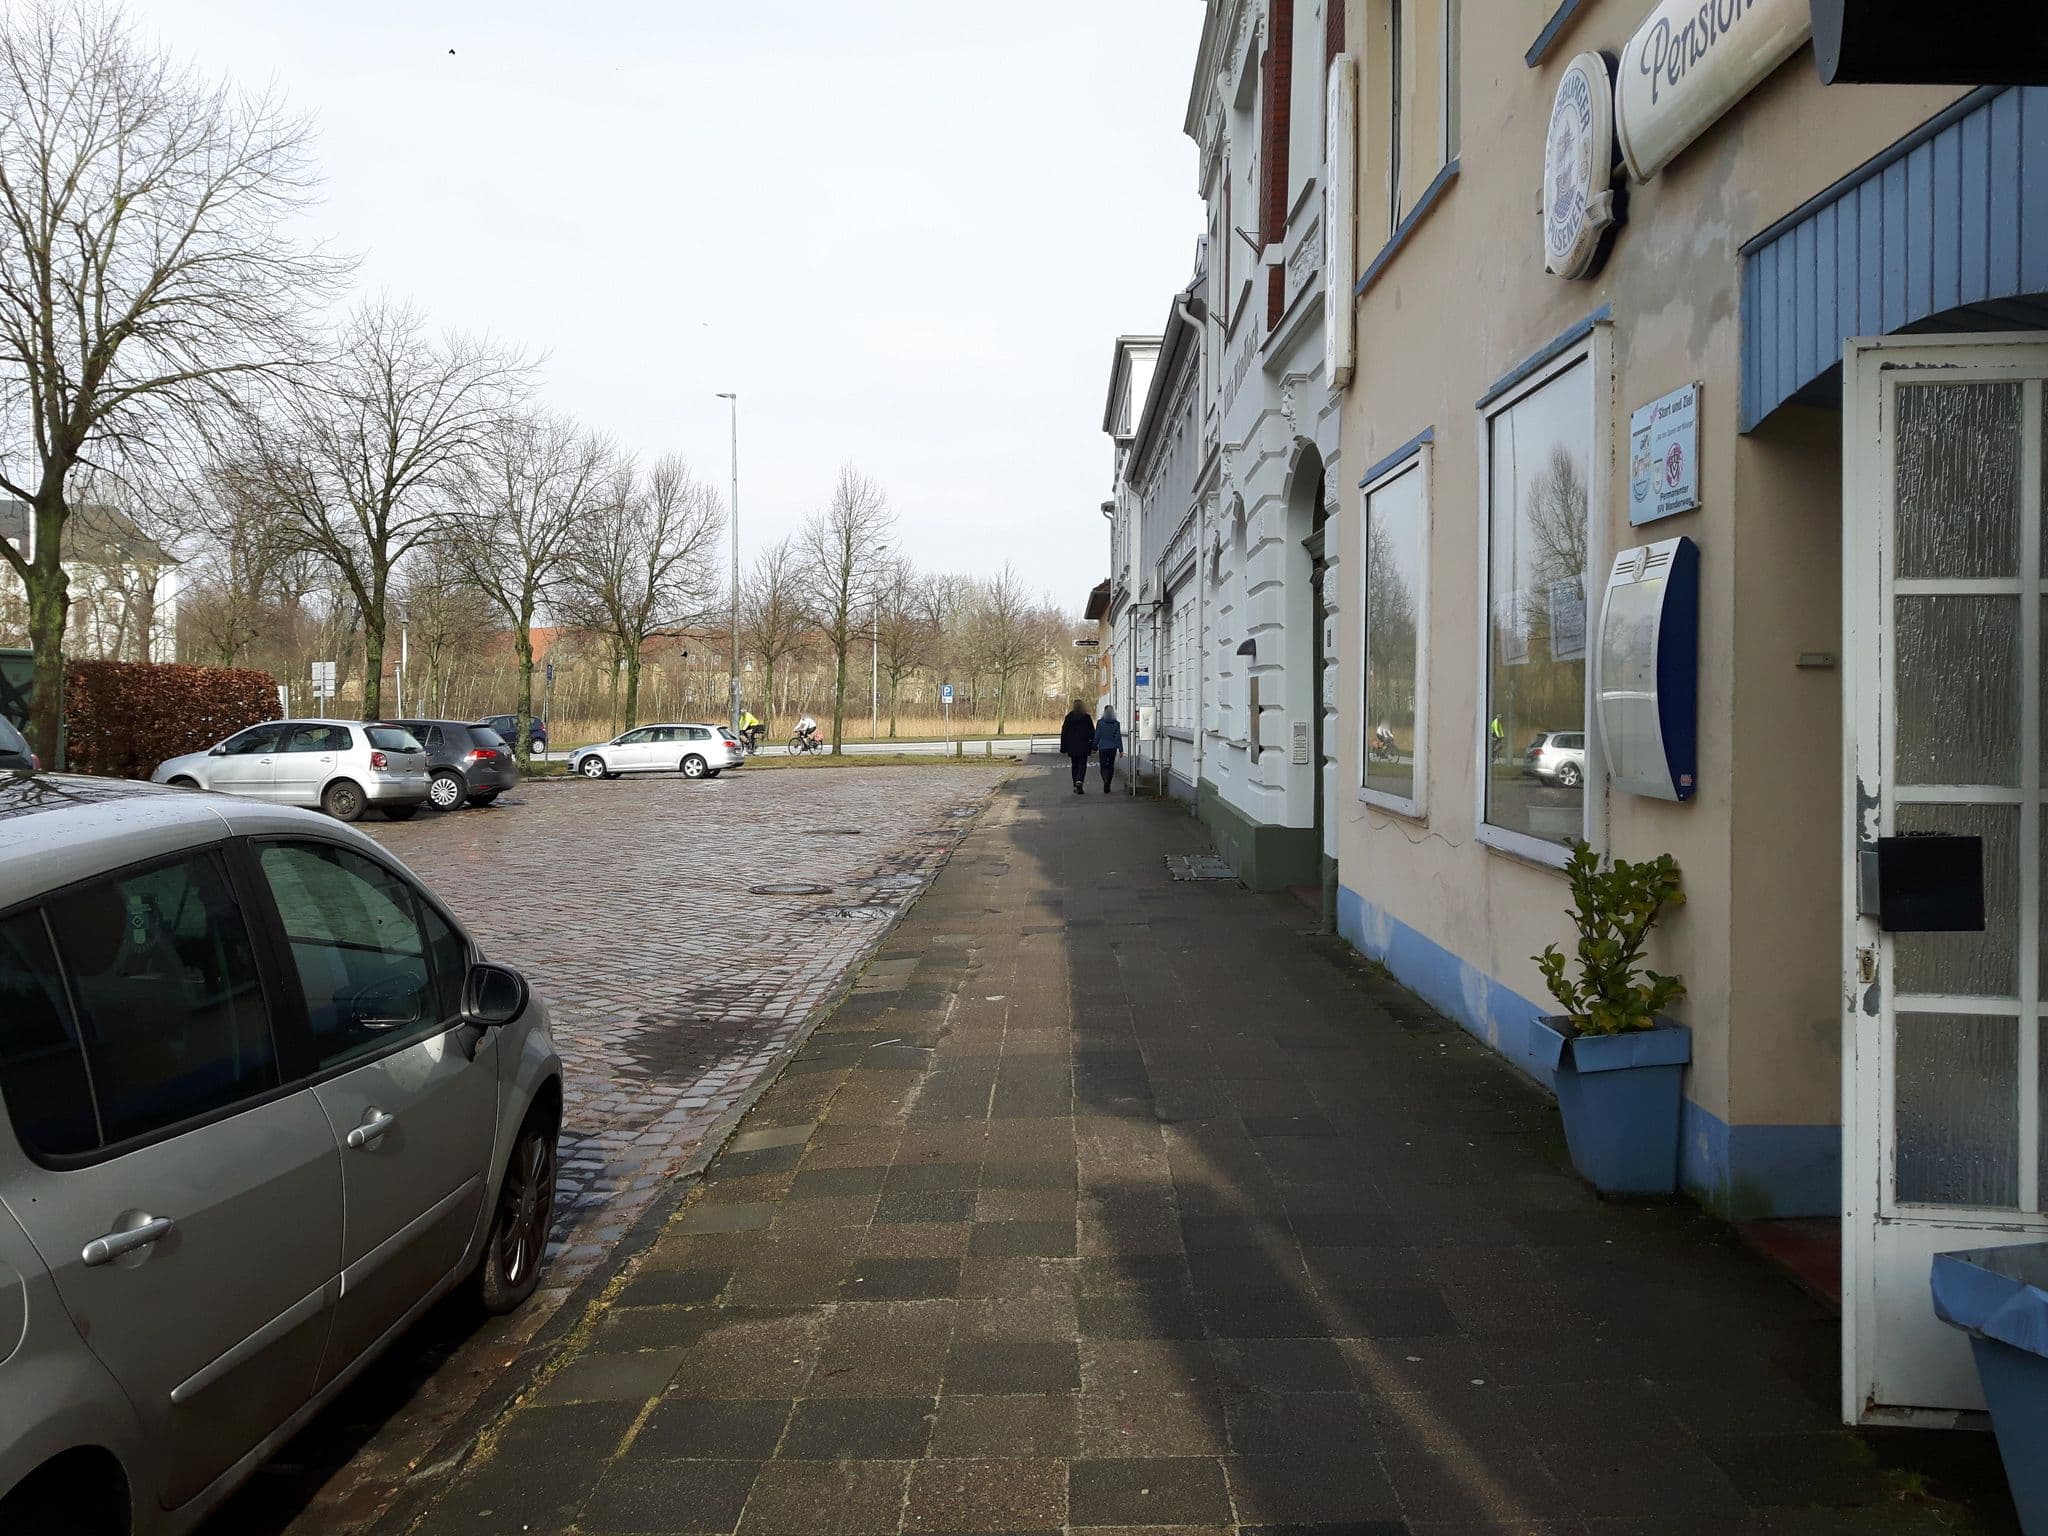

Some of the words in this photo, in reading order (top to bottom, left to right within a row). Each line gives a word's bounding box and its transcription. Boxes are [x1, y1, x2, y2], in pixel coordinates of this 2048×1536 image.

[1547, 191, 1585, 250] PILSENER
[1658, 403, 1671, 419] Start
[1672, 398, 1682, 413] und
[1683, 392, 1694, 408] Ziel
